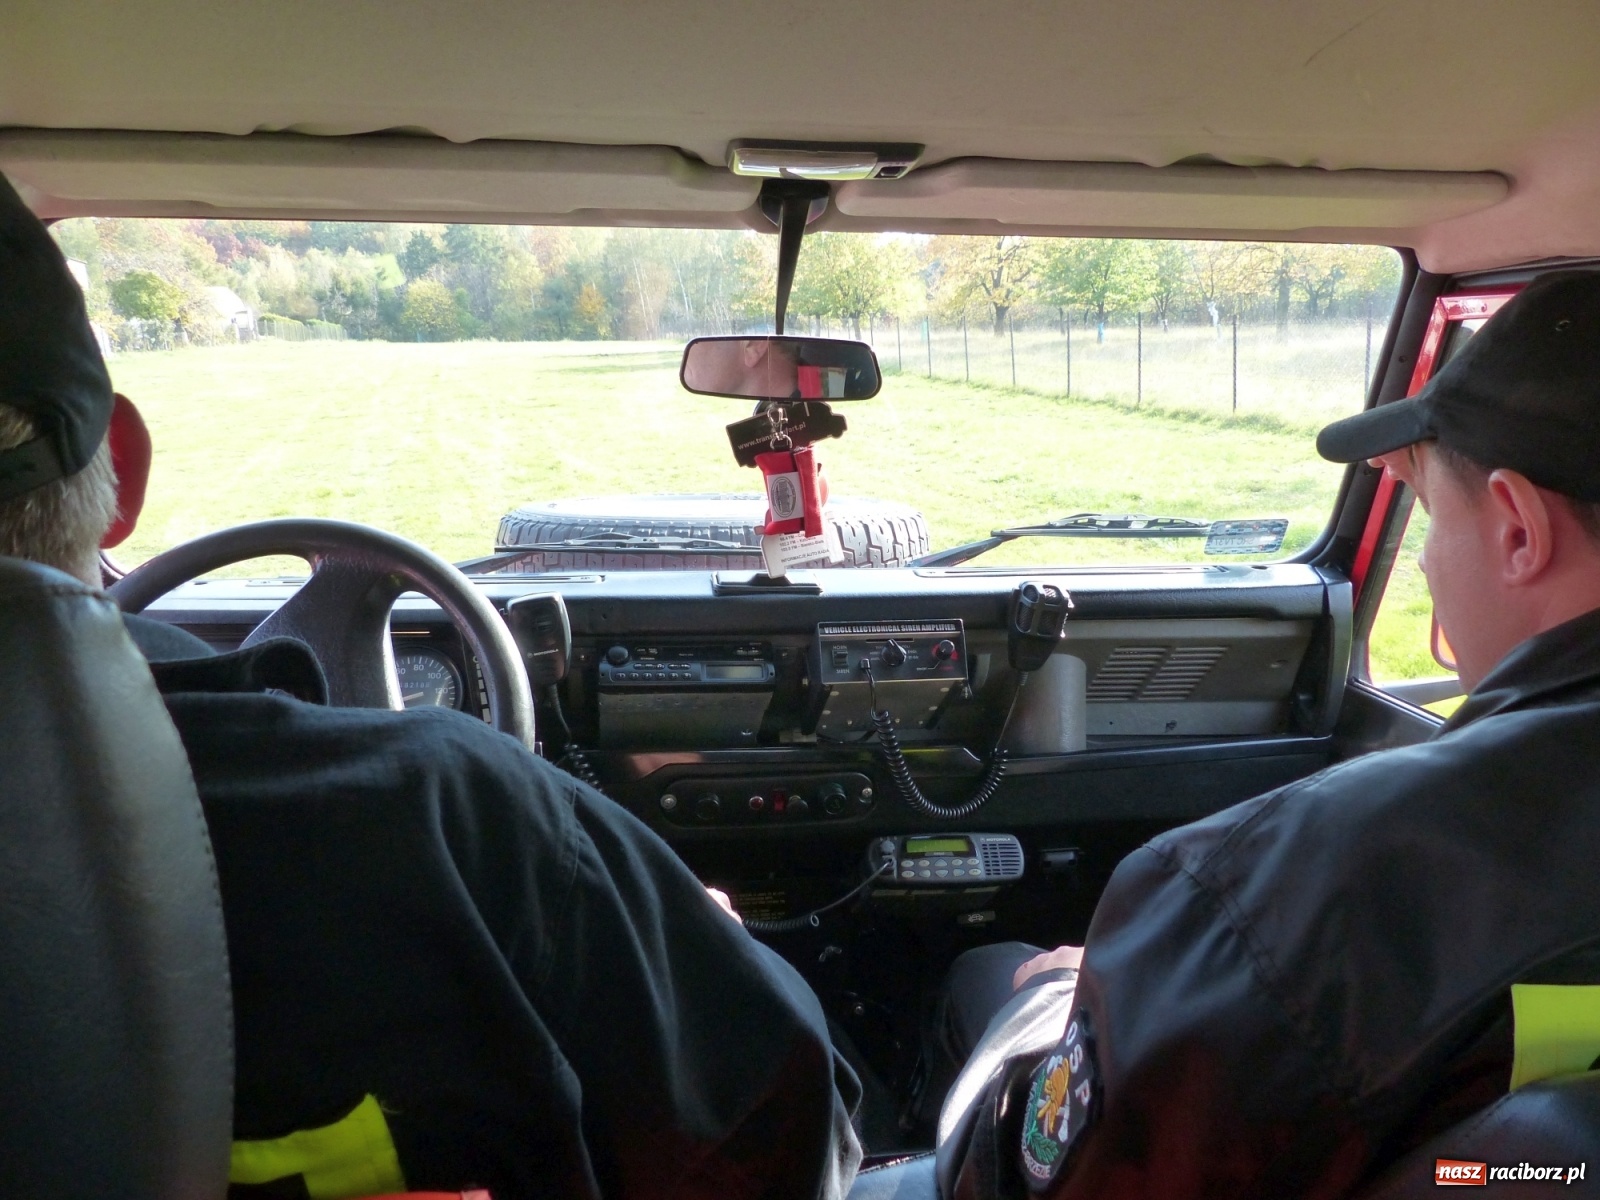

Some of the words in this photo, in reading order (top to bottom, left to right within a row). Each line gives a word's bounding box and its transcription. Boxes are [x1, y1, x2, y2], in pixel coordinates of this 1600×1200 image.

[824, 626, 852, 634] VEHICLE
[852, 625, 901, 633] ELECTRONICAL
[901, 624, 921, 632] SIREN
[921, 623, 956, 631] AMPLIFIER
